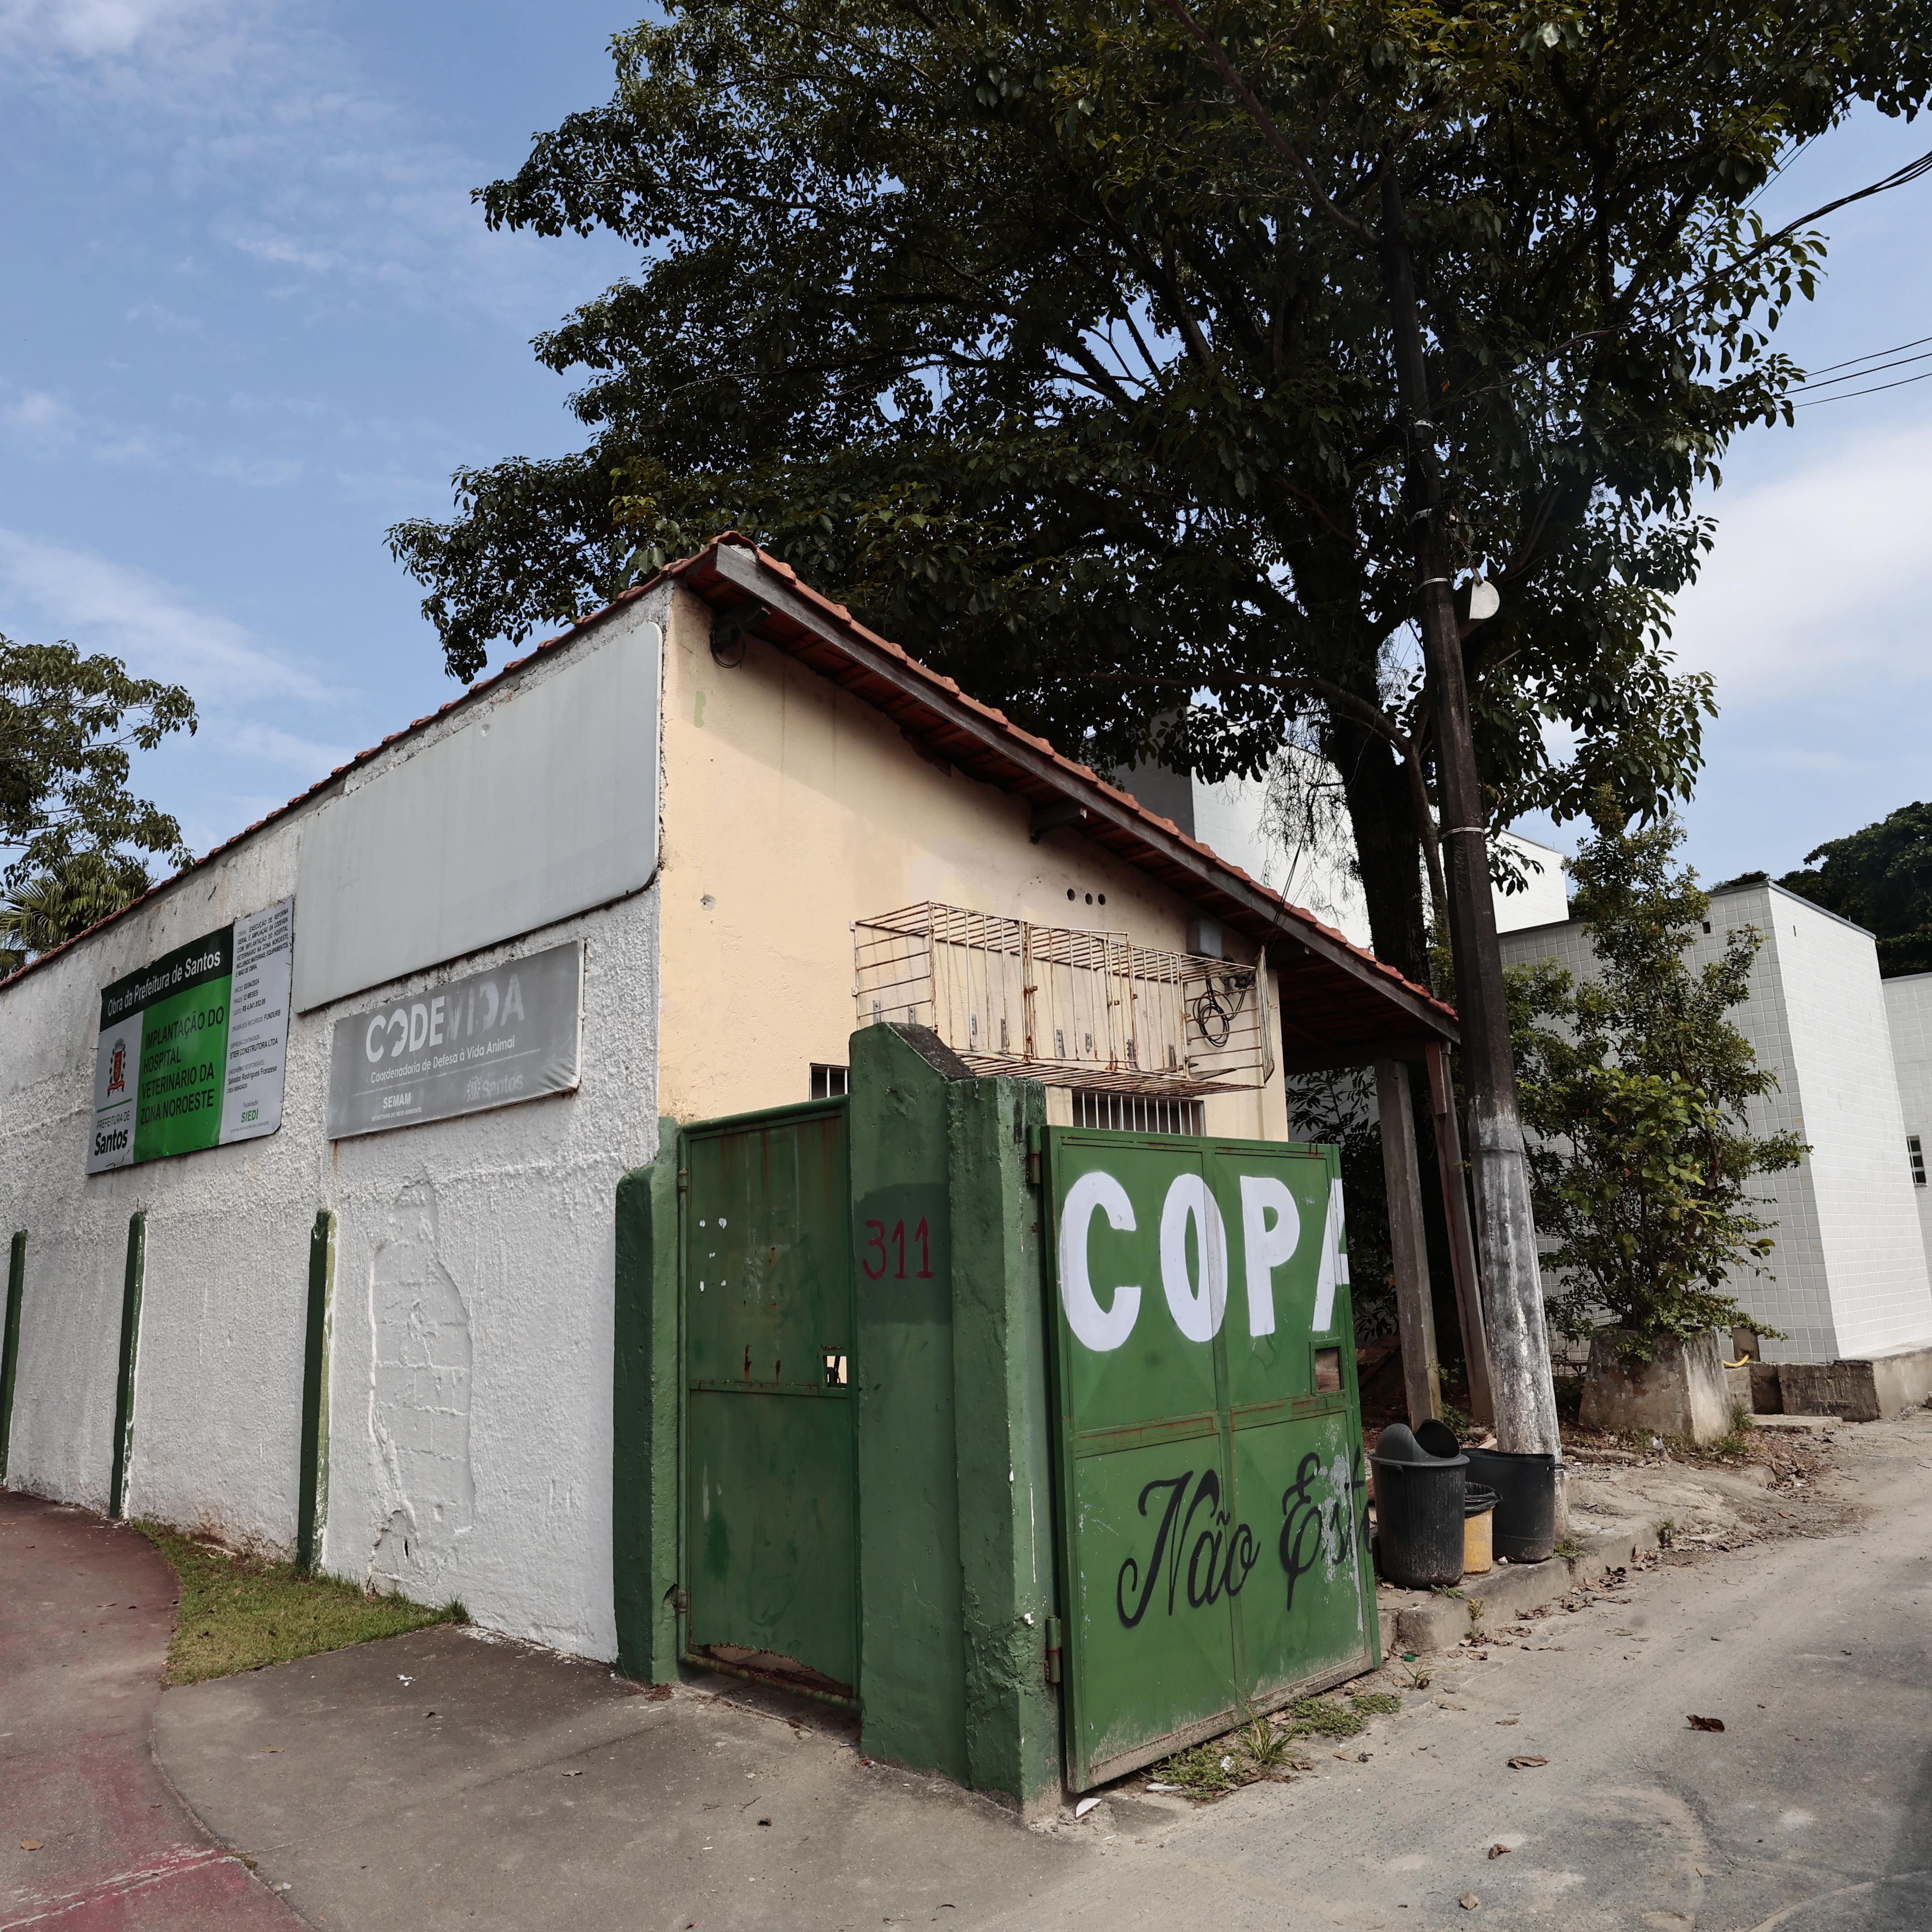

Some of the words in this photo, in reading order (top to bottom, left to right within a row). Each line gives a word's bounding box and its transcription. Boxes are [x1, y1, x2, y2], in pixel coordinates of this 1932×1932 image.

[237, 937, 247, 945] GERAL
[252, 925, 268, 938] AMPLIAÇÃO
[274, 916, 288, 928] CODEVIDA
[249, 920, 267, 932] EXECUÇÃO
[274, 908, 288, 920] REFORMA
[245, 935, 267, 950] IMPLANTAÇÃO
[274, 925, 288, 938] HOSPITAL
[262, 941, 271, 950] ZONA
[236, 958, 251, 969] INCLUINDO
[108, 997, 123, 1017] Obra
[124, 990, 132, 1008] da
[134, 972, 170, 1003] Prefeitura
[171, 964, 182, 984] de
[185, 951, 221, 978] Santos
[247, 990, 258, 999] MESES
[264, 1009, 281, 1021] FUNDURB
[366, 973, 525, 1063] CODEVIDA
[145, 1010, 205, 1050] IMPLANTAÇÃO
[208, 1006, 224, 1027] DO
[230, 1050, 240, 1059] STIER
[240, 1041, 267, 1056] CONSTRUTORA
[268, 1037, 278, 1047] LTDA
[370, 1061, 421, 1083] Coordenadoria
[422, 1058, 431, 1071] de
[433, 1052, 458, 1069] Defesa
[459, 1048, 465, 1062] à
[467, 1044, 484, 1059] Vida
[486, 1035, 515, 1055] Animal
[143, 1046, 181, 1075] HOSPITAL
[142, 1066, 197, 1100] VETERINÁRIO
[199, 1062, 214, 1082] DA
[228, 1075, 242, 1085] Salvador
[242, 1070, 260, 1080] Rodrigues
[260, 1065, 277, 1076] Franzese
[483, 1074, 523, 1098] Santos
[140, 1103, 161, 1125] ZONA
[163, 1088, 214, 1119] NOROESTE
[383, 1092, 412, 1109] SEMAM
[97, 1112, 123, 1130] PREFEITURA
[124, 1110, 130, 1121] DE
[242, 1109, 259, 1123] SIEDI
[371, 1112, 391, 1122] SECRETARIA
[404, 1107, 422, 1116] AMBIENTE
[94, 1129, 128, 1156] Santos
[862, 1216, 935, 1280] 311
[1117, 1469, 1261, 1629] Não
